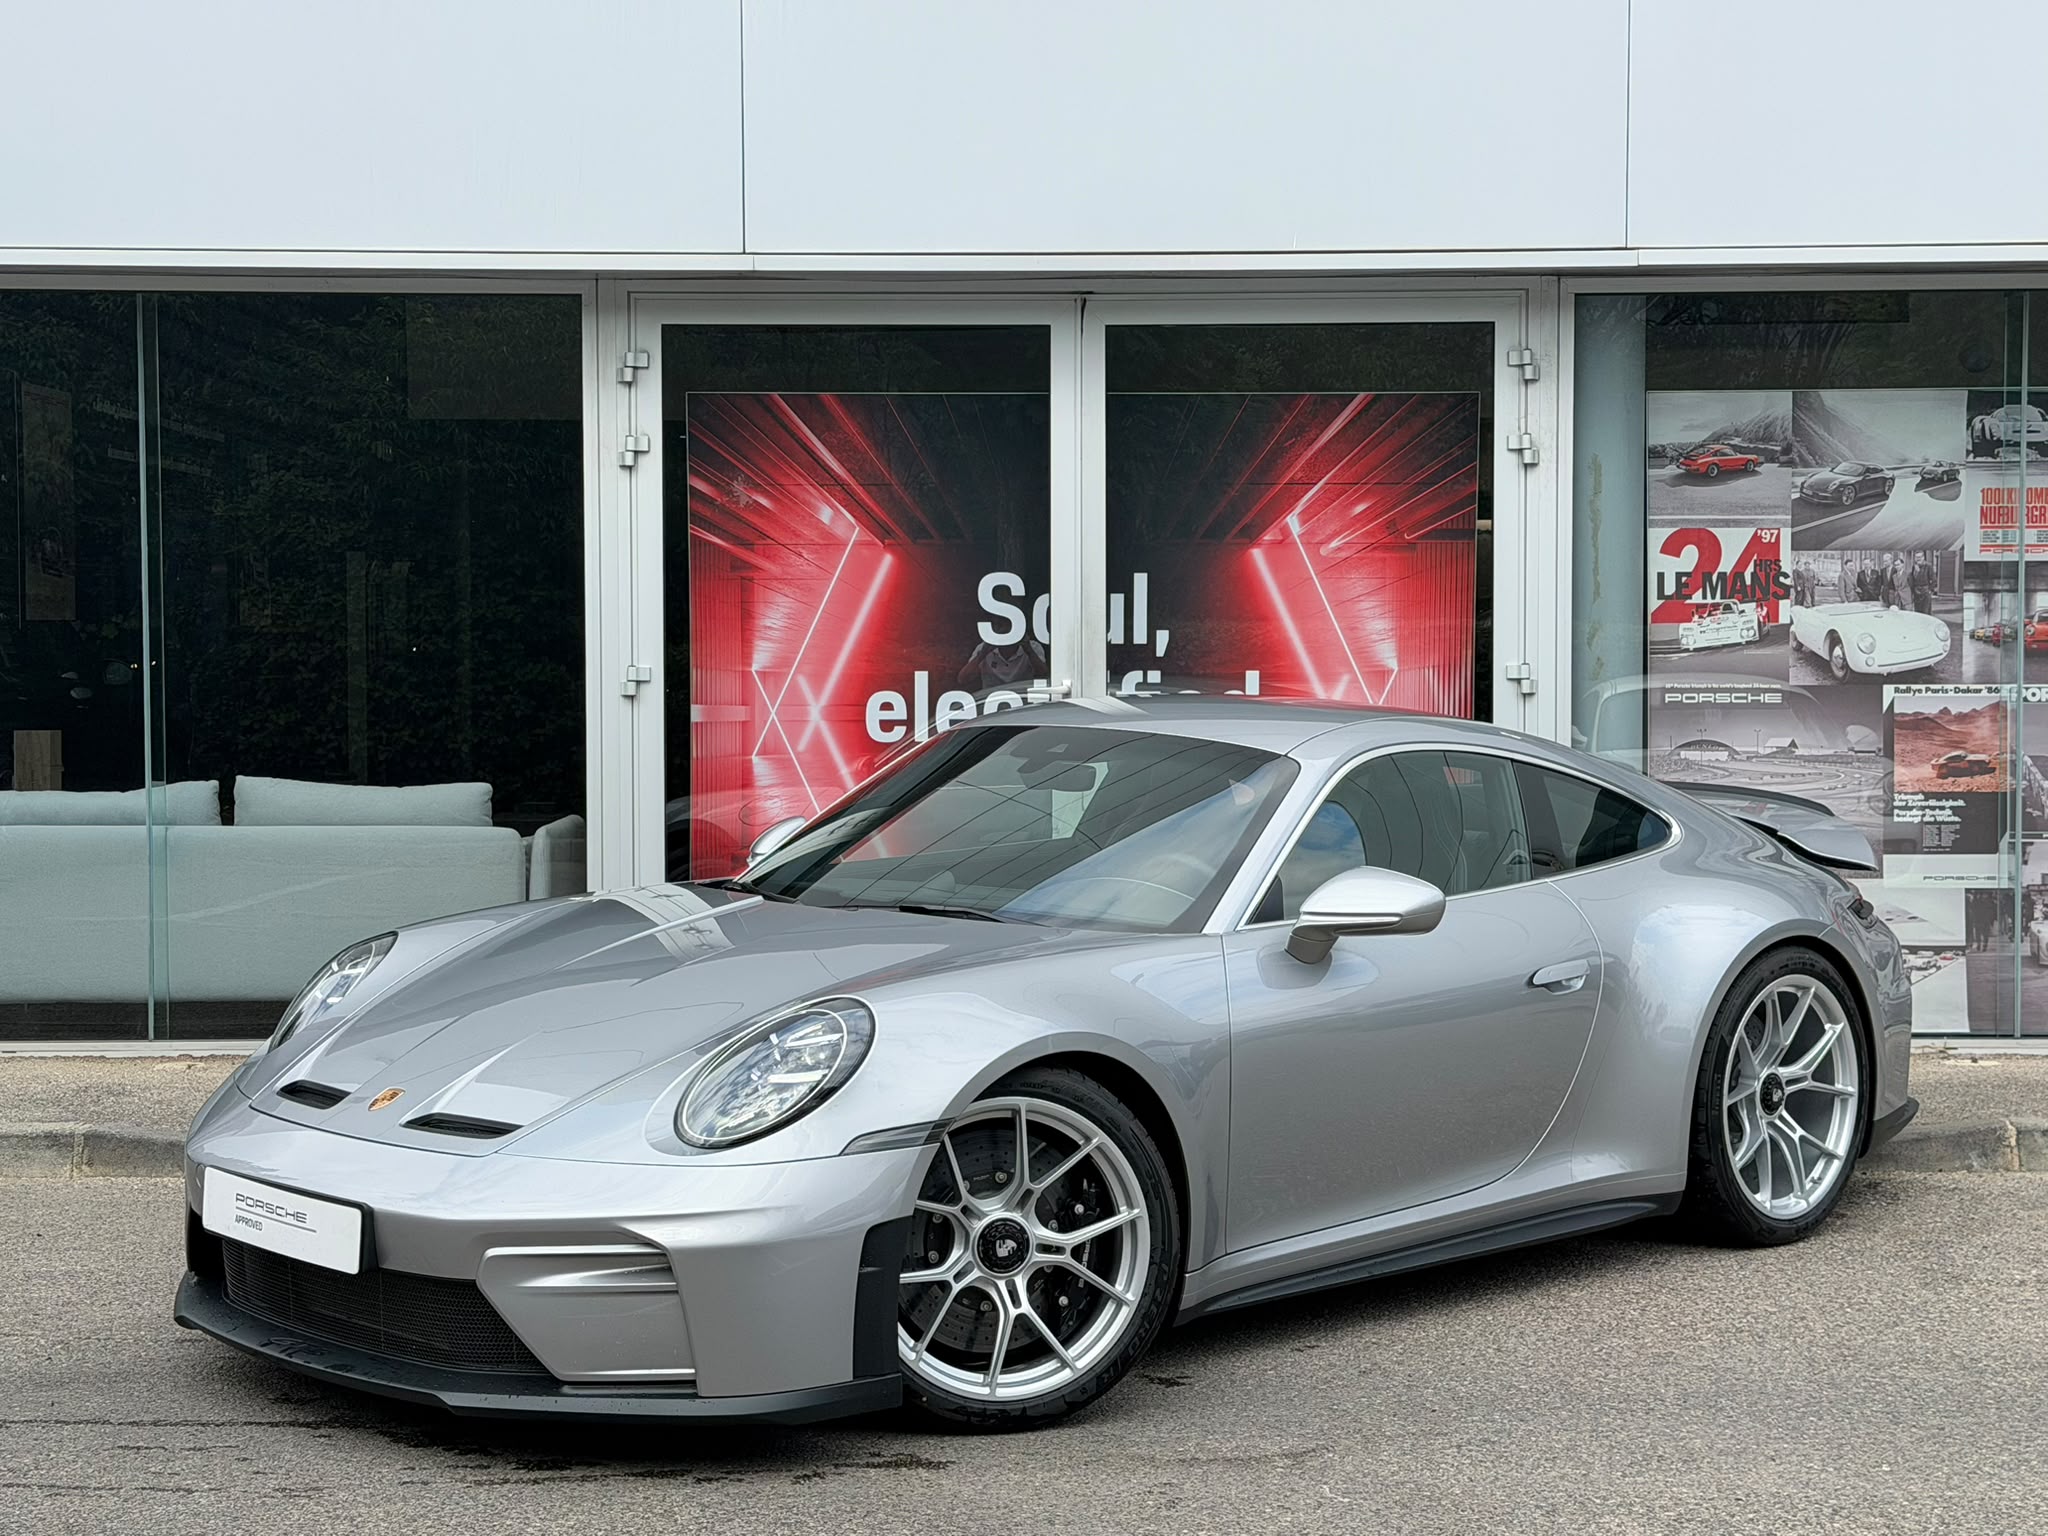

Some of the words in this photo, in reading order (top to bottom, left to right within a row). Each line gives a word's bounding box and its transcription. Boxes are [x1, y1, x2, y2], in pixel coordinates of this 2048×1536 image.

[1757, 529, 1779, 543] '97
[1753, 558, 1782, 574] HRS
[1651, 527, 1780, 624] 24
[1656, 571, 1692, 600] LE
[1701, 571, 1791, 602] MANS
[1664, 693, 1782, 703] PORSCHE
[1894, 686, 1923, 697] Rallye
[1984, 686, 2000, 694] '86
[235, 1193, 308, 1224] PORSCHE
[234, 1214, 264, 1232] APPROVED
